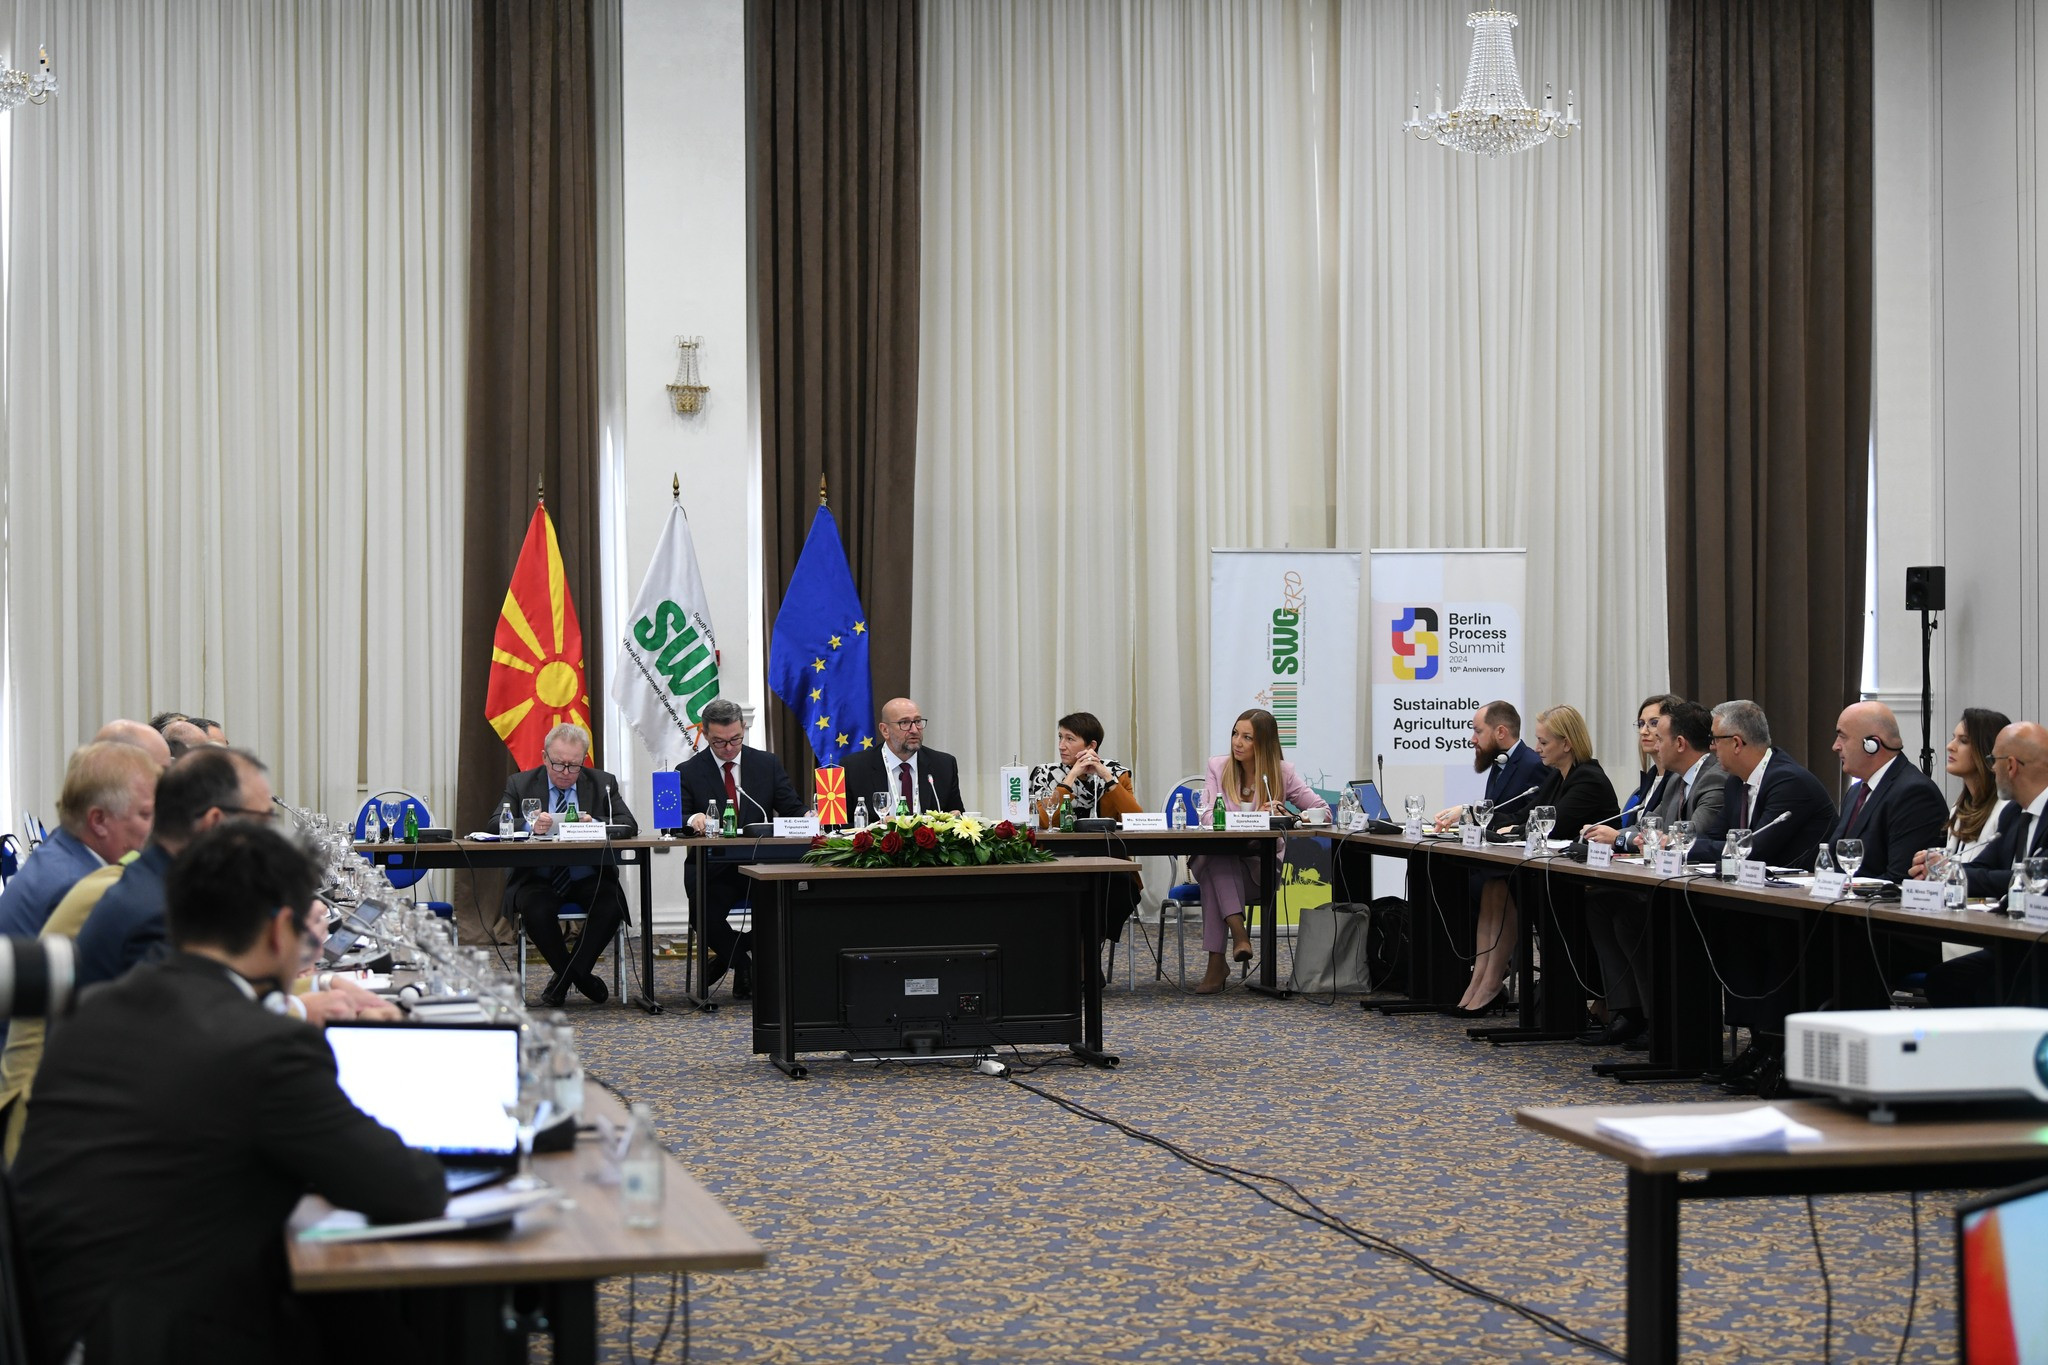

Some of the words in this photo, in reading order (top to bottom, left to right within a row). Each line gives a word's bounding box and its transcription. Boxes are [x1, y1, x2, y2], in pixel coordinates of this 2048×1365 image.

[692, 612, 707, 631] South
[1449, 612, 1491, 625] Berlin
[1449, 627, 1507, 639] Process
[1272, 608, 1299, 675] SWG
[1448, 641, 1505, 653] Summit
[1449, 655, 1468, 663] 2024
[624, 641, 638, 658] Rural
[633, 656, 663, 696] Development
[659, 694, 679, 722] Standing
[677, 719, 694, 746] Working
[1393, 698, 1480, 710] Sustainable
[1393, 717, 1474, 733] Agriculture
[1394, 737, 1430, 749] Food
[1435, 736, 1475, 752] Syste
[1010, 777, 1021, 802] SWG
